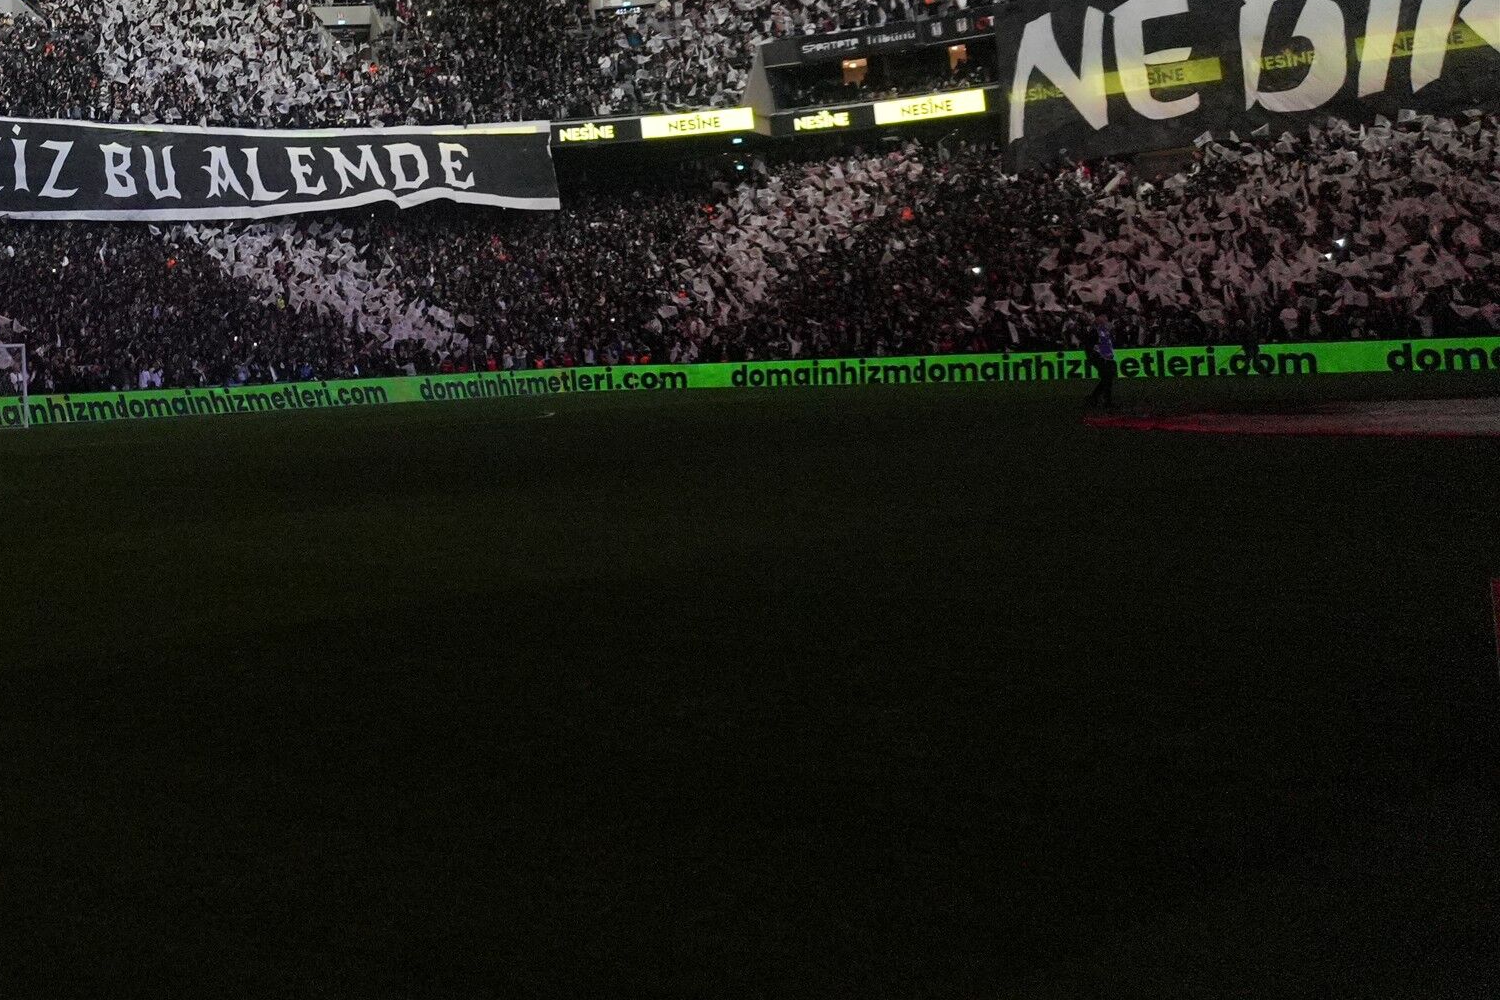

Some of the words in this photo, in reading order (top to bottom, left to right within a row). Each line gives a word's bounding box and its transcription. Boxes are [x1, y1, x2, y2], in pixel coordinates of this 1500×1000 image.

[901, 98, 953, 116] NESİNE
[668, 114, 722, 132] NESİNE
[794, 110, 850, 131] NESİNE
[559, 122, 614, 142] NESİNE
[98, 141, 182, 200] BU
[201, 141, 476, 202] ALEMDE
[420, 366, 688, 401] domainhizmetleri.com
